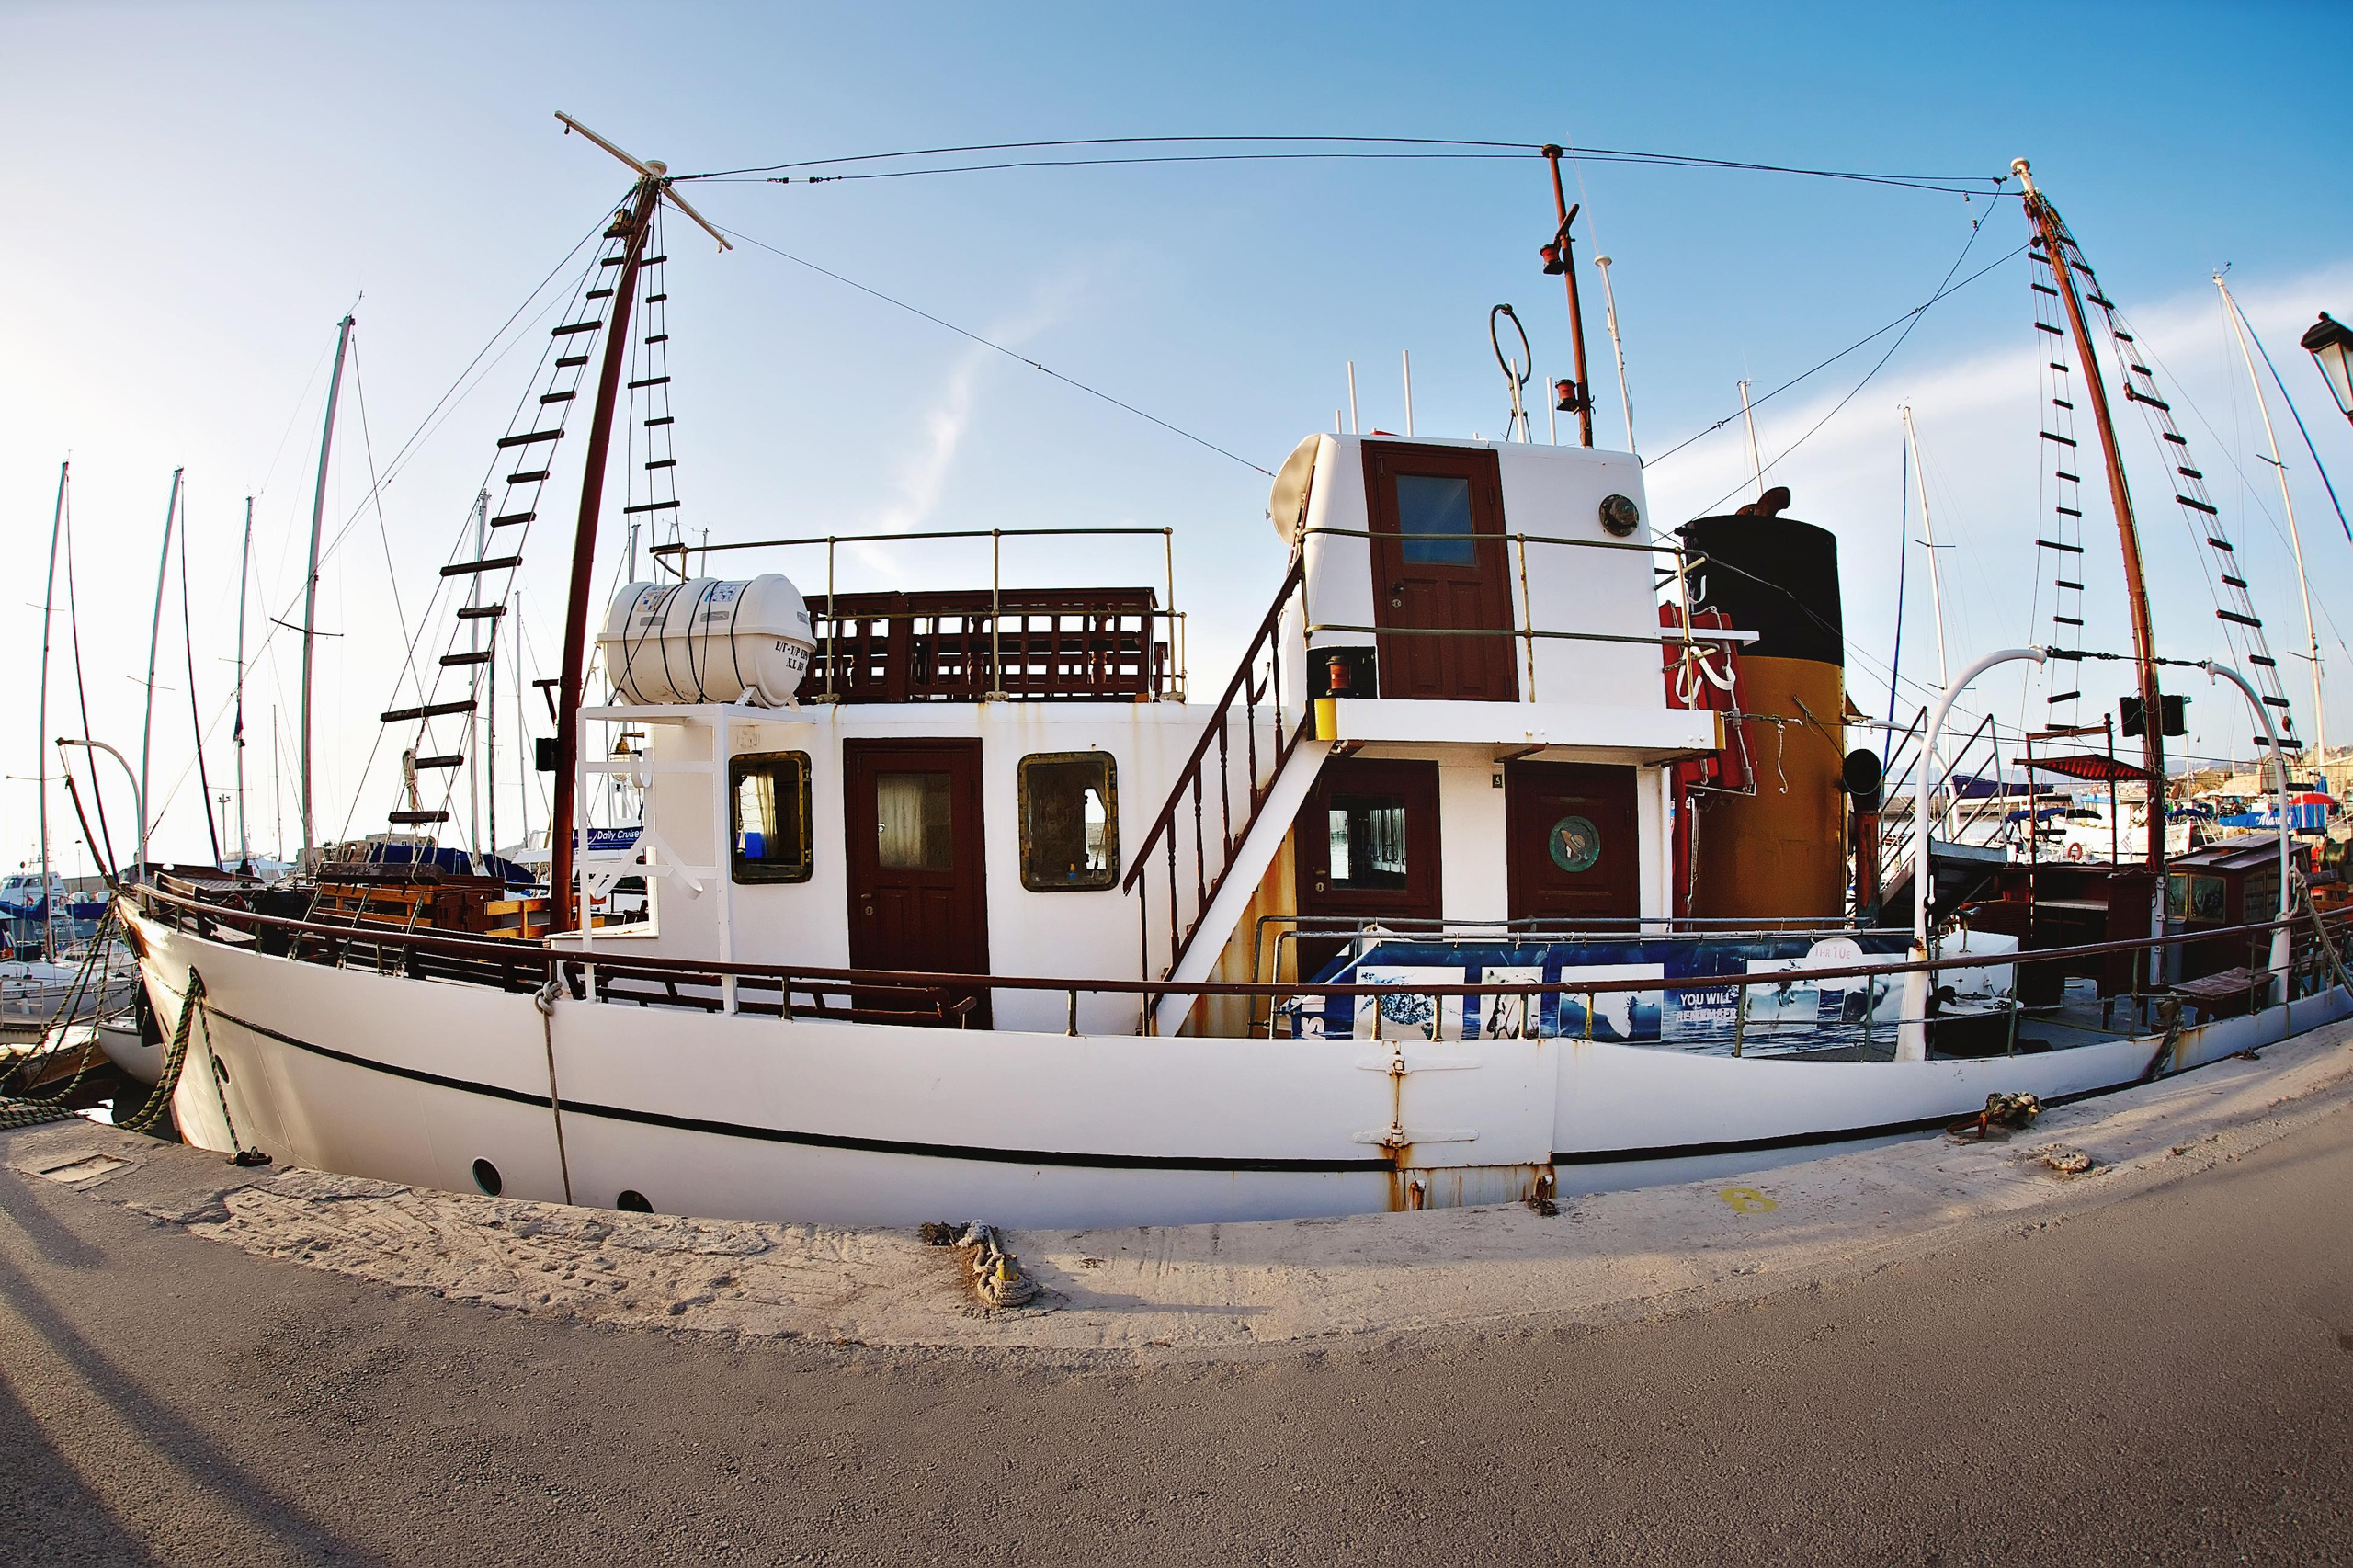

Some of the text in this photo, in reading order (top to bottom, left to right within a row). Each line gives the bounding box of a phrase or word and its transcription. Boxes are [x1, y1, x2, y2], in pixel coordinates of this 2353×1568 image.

[597, 830, 616, 841] Daily
[1680, 992, 1733, 1006] YOU WILL
[1720, 1187, 1779, 1214] 8
